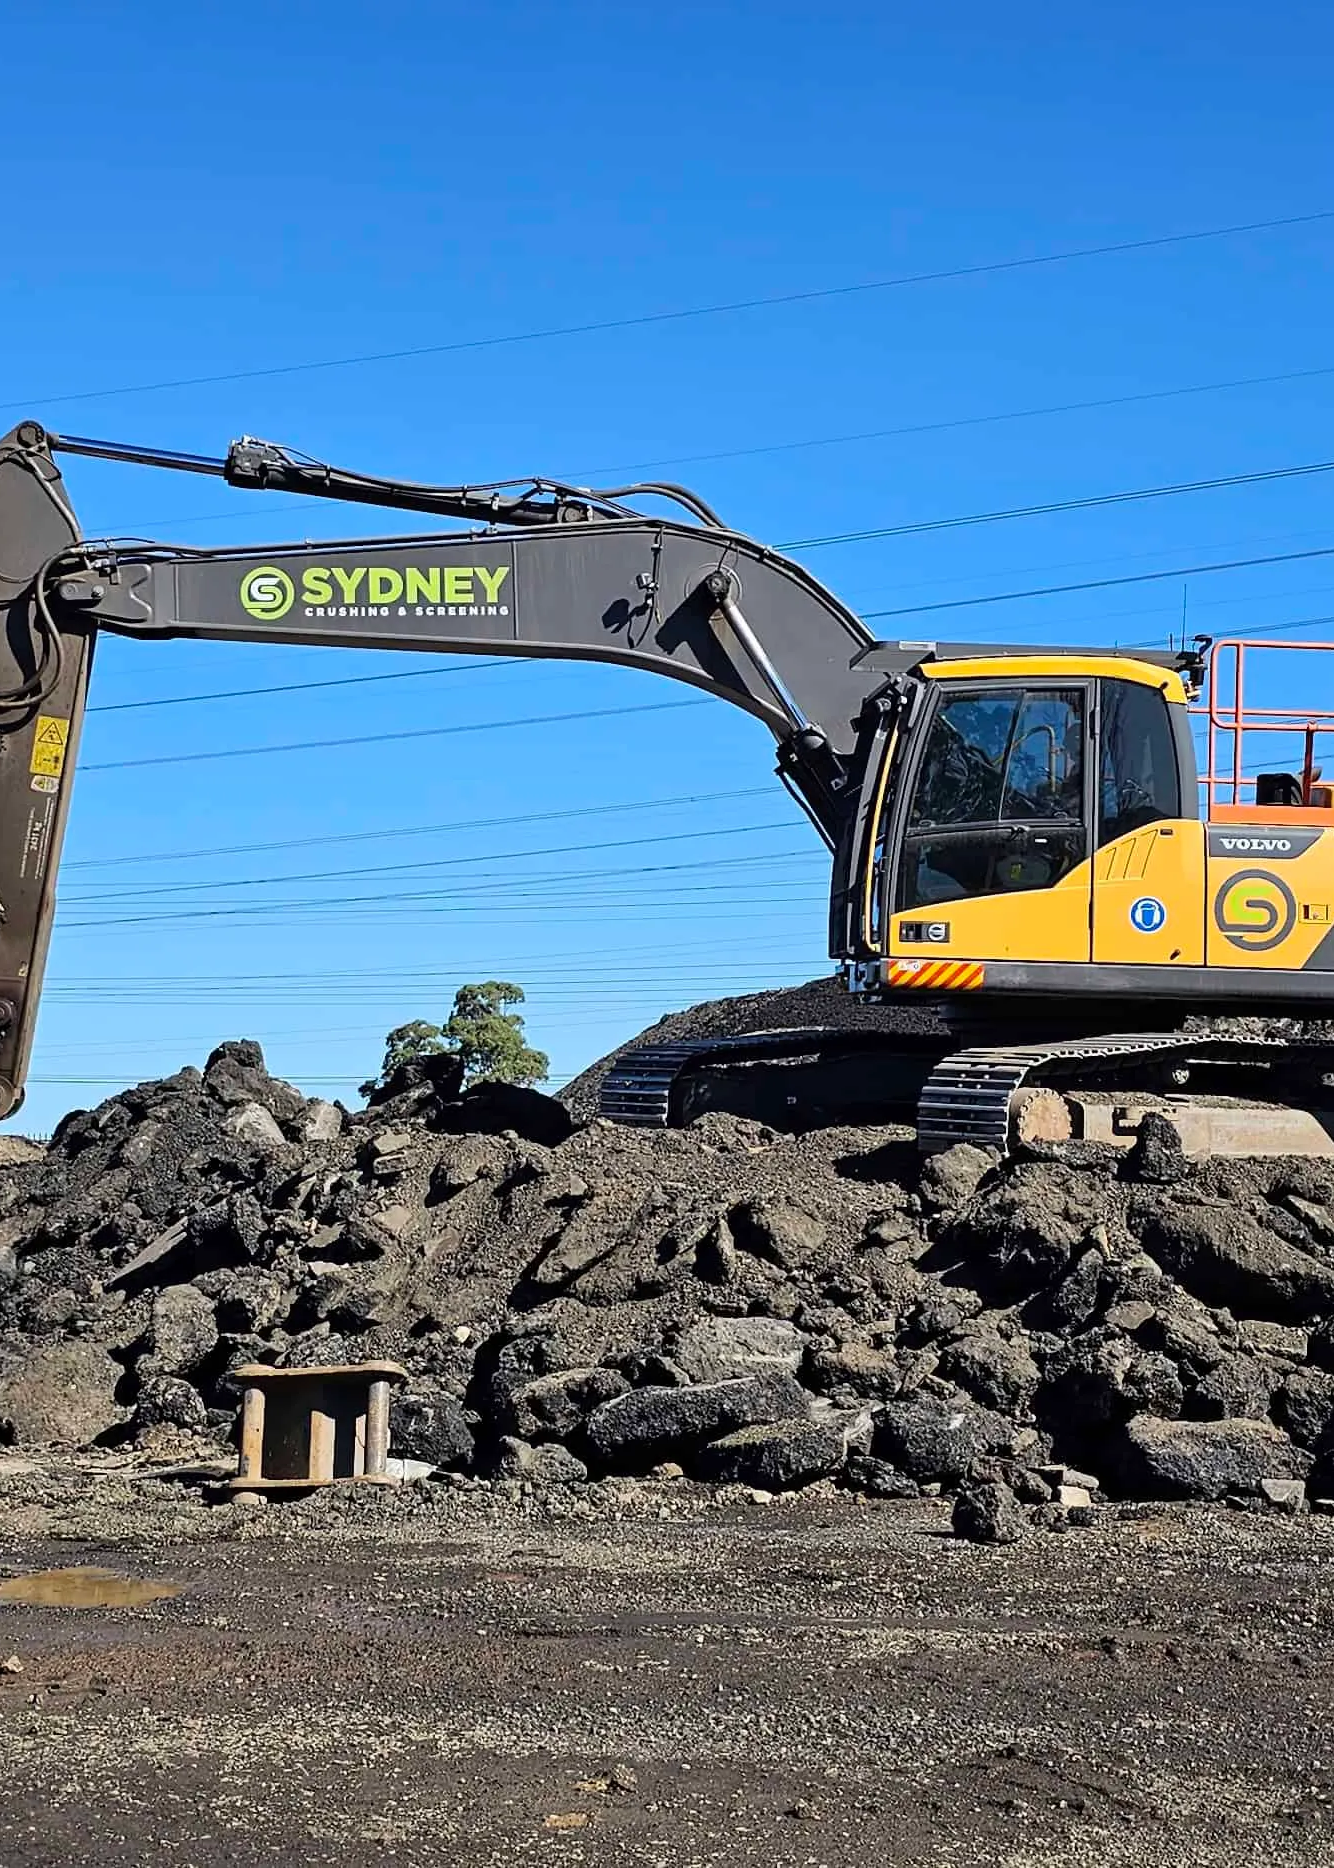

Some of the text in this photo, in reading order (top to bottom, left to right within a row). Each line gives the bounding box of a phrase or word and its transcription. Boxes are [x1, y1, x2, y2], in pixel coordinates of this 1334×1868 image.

[301, 567, 510, 604] SYDNEY
[304, 606, 509, 617] CRUSHING & SCREENING
[1219, 838, 1291, 851] VOLVO
